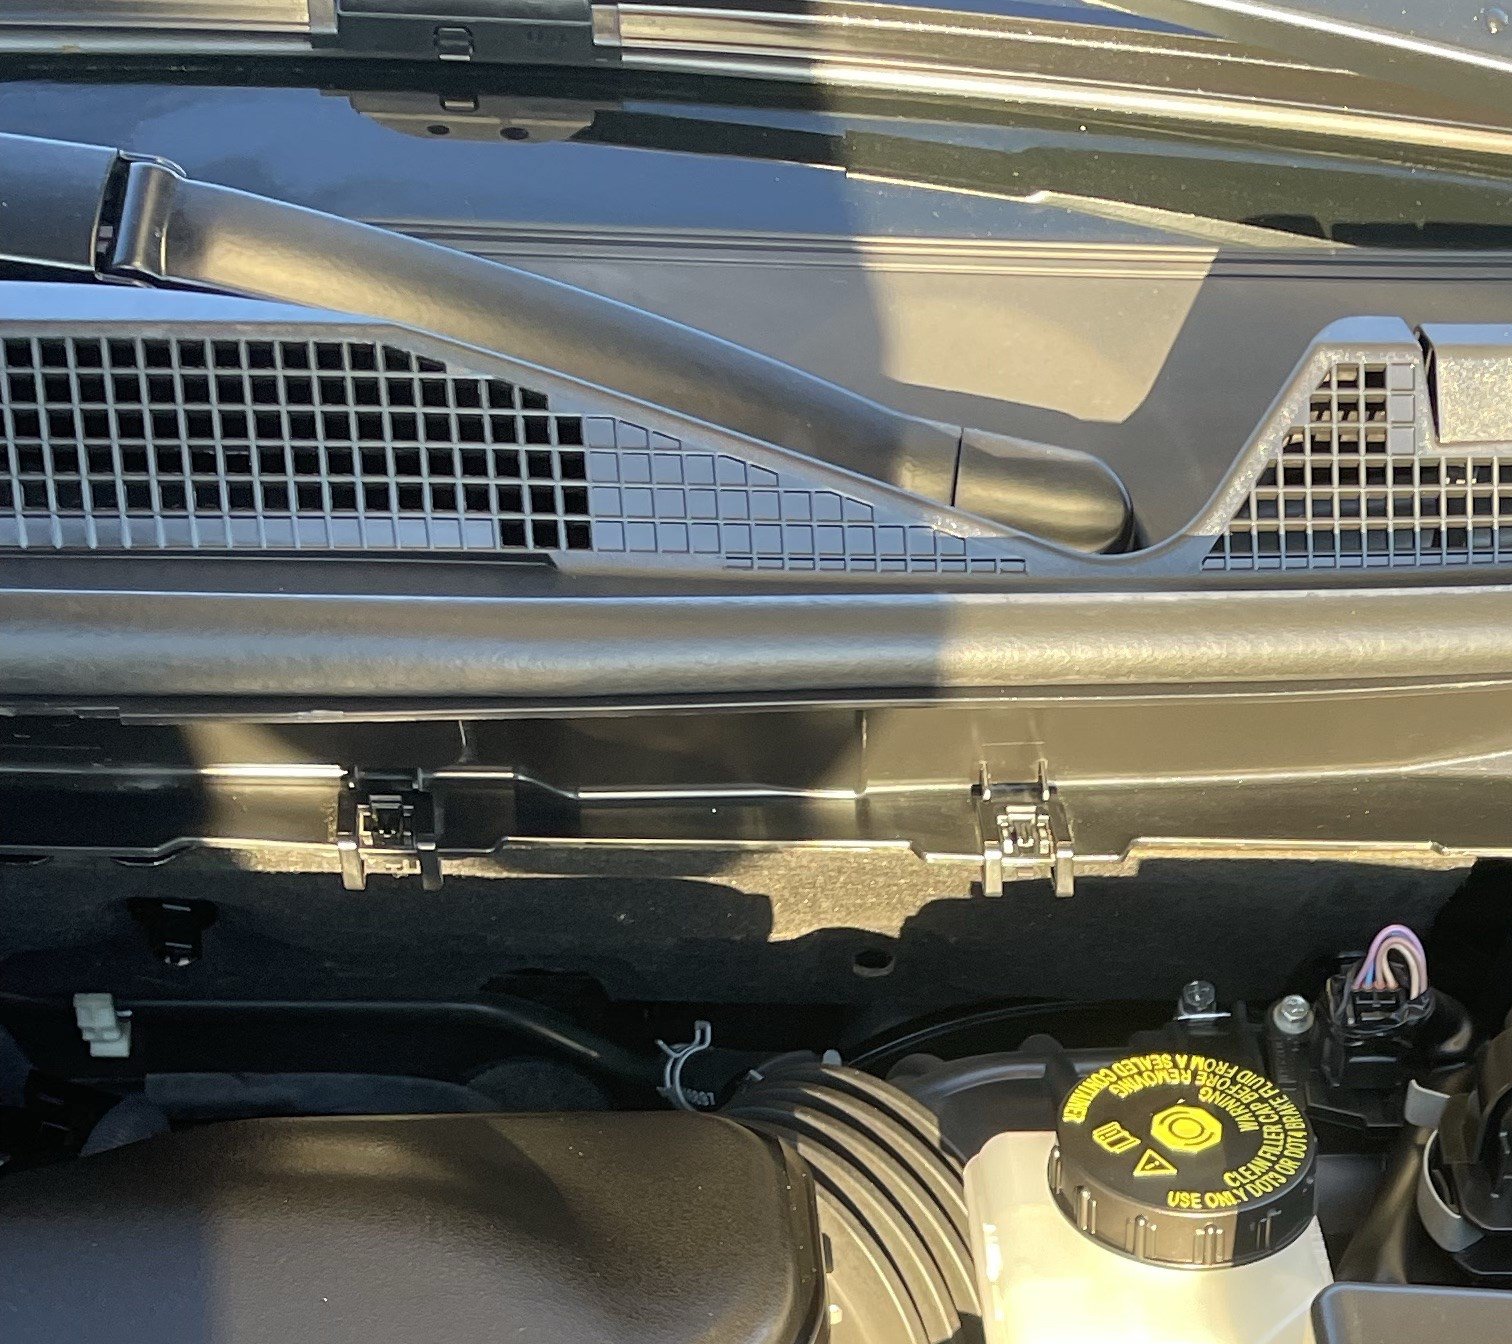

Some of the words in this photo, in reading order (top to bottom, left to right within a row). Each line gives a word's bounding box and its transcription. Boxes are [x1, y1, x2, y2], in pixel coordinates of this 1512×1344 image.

[1111, 1053, 1174, 1077] SEALED
[1175, 1054, 1189, 1069] A
[1190, 1055, 1239, 1079] FROM
[1062, 1067, 1118, 1124] CONTAINER
[1108, 1068, 1192, 1099] REMOVING
[1194, 1070, 1259, 1104] BEFORE
[1235, 1069, 1279, 1098] FLUID
[1198, 1086, 1260, 1133] WARNING
[1249, 1102, 1280, 1124] CAP
[1268, 1093, 1306, 1130] BRAKE
[1257, 1123, 1285, 1161] FILLER
[1283, 1131, 1308, 1159] DOT4
[1223, 1157, 1273, 1188] CLEAN
[1274, 1157, 1301, 1176] OR
[1204, 1186, 1249, 1208] ONLY
[1245, 1171, 1287, 1198] DOT3
[1167, 1190, 1202, 1208] USE
